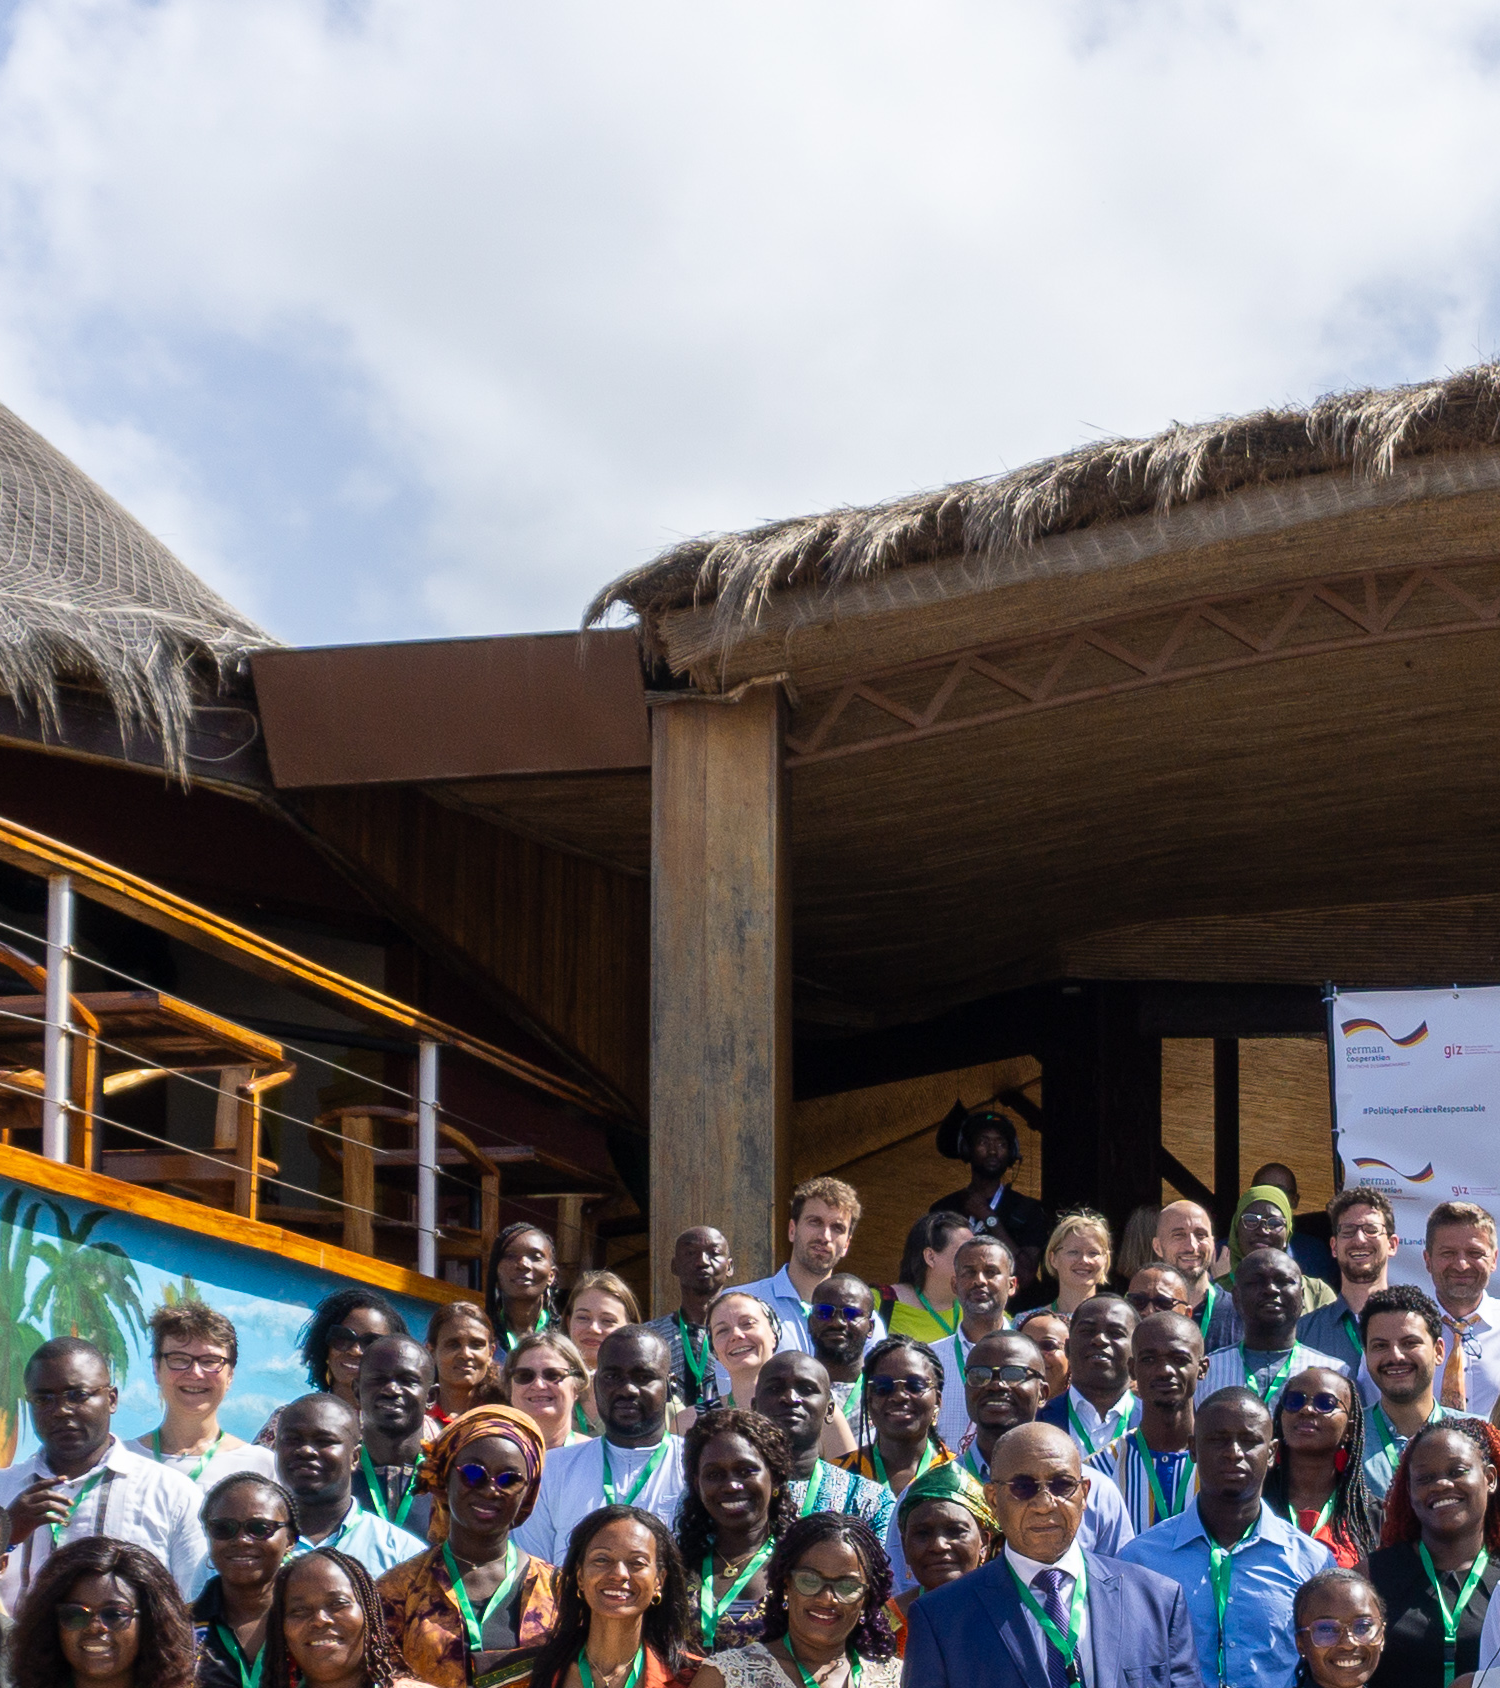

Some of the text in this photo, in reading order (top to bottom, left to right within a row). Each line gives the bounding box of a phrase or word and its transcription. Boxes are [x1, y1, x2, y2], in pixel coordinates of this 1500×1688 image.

[1345, 1045, 1384, 1056] german
[1444, 1044, 1463, 1058] giz
[1346, 1055, 1391, 1063] cooperation
[1362, 1104, 1486, 1116] #PolitiqueFoncièreResponsable
[1360, 1177, 1397, 1187] german
[1452, 1185, 1470, 1197] giz
